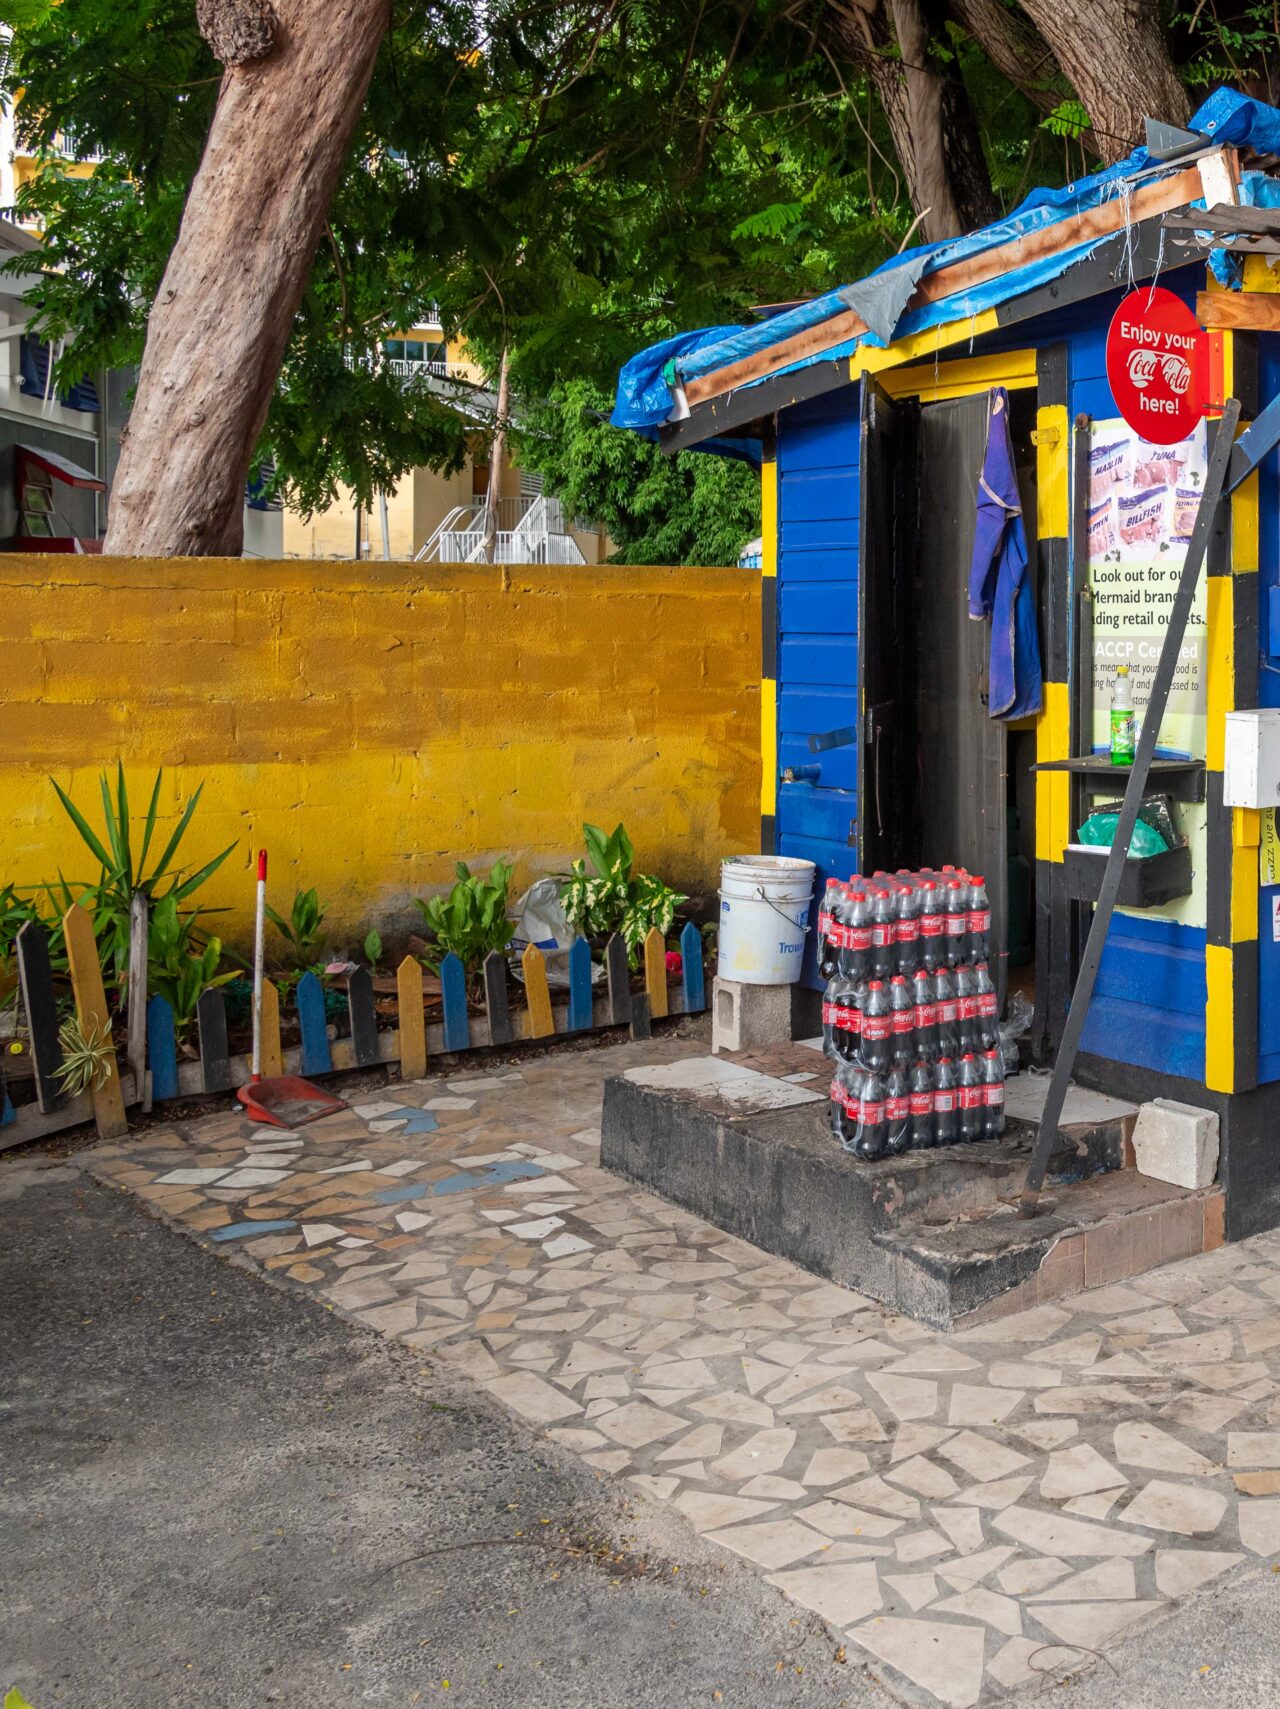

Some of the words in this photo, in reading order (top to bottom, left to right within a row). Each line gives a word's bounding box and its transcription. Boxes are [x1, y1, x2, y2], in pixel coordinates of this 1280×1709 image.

[1121, 321, 1161, 347] Enjoy
[1164, 332, 1197, 350] your
[1139, 391, 1179, 415] here!
[1151, 450, 1177, 461] TUNA
[1094, 454, 1124, 476] MARLIN
[1126, 503, 1162, 527] BILLFISH
[1093, 569, 1122, 582] Look
[1127, 569, 1145, 582] out
[1147, 568, 1166, 580] for
[1169, 570, 1184, 581] ou
[1092, 589, 1141, 603] Mermaid
[1122, 611, 1154, 625] retail
[1094, 641, 1135, 658] ACCP
[1136, 679, 1151, 689] and
[1191, 680, 1199, 691] to
